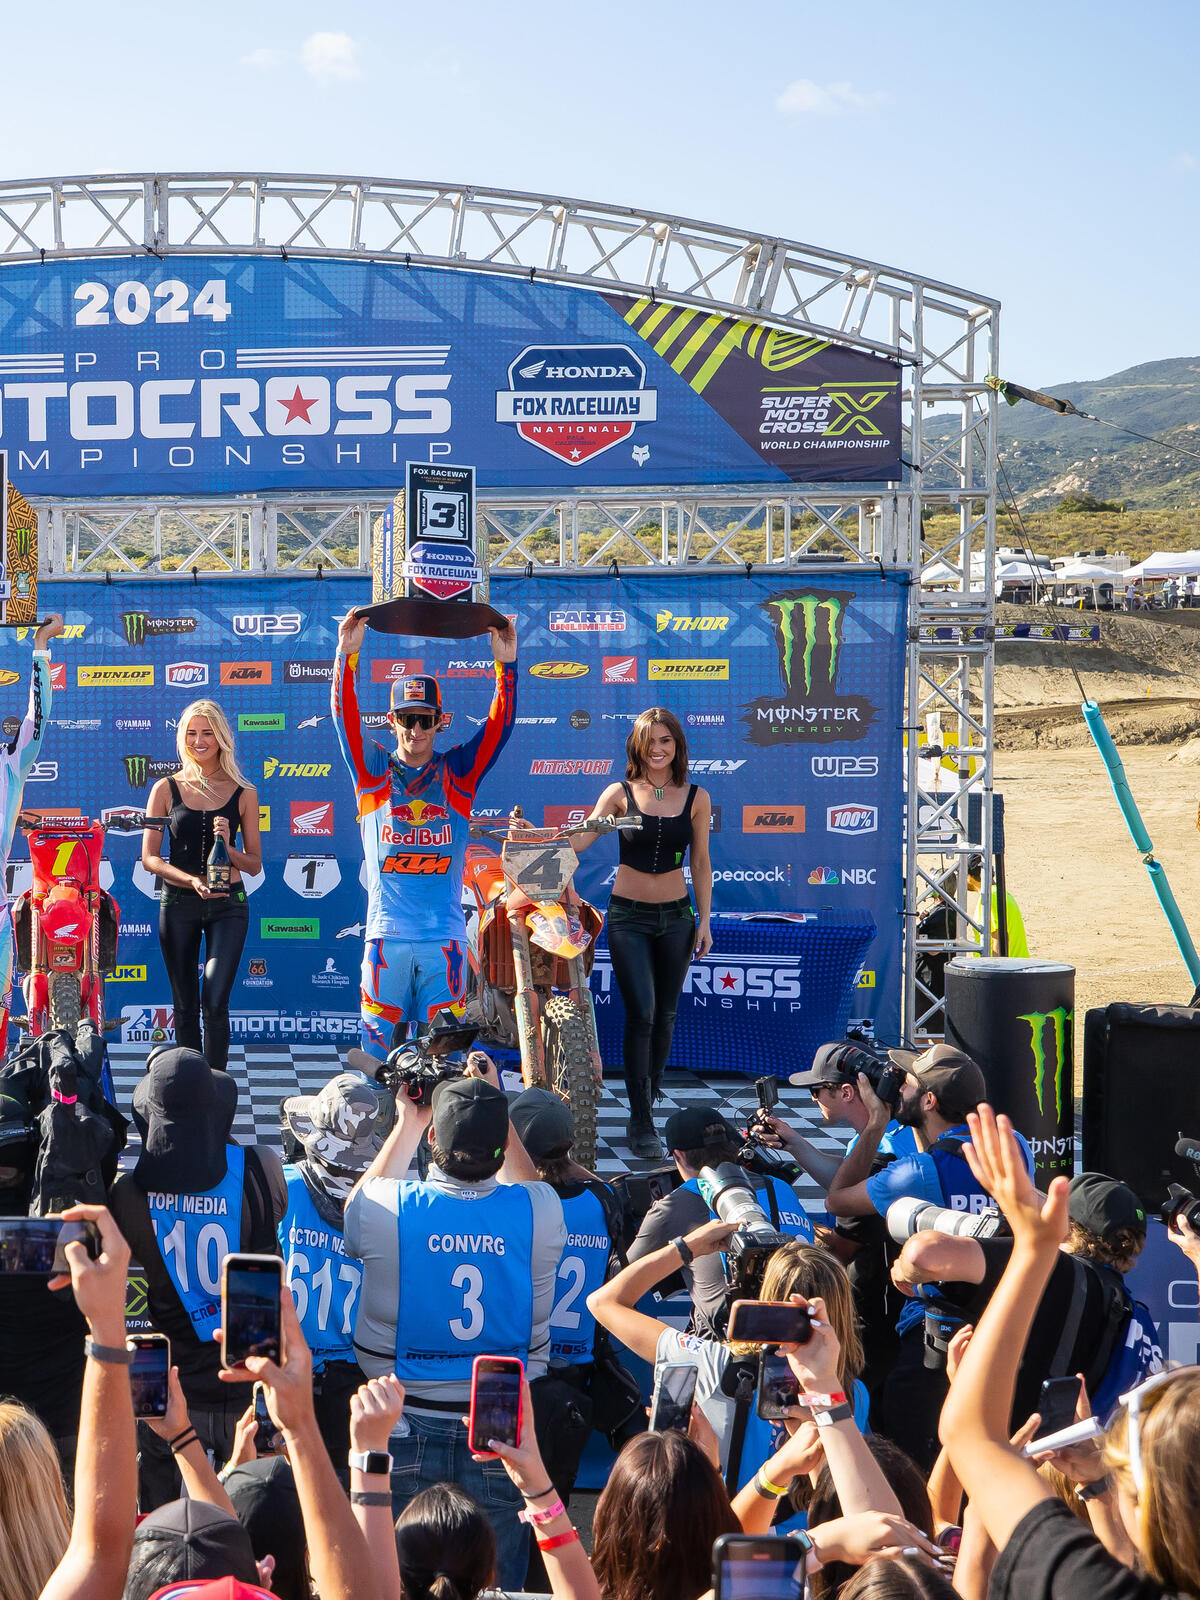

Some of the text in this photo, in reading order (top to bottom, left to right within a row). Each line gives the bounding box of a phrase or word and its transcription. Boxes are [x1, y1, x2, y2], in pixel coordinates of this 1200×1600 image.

[74, 280, 232, 326] 2024
[75, 349, 225, 372] PRO
[546, 366, 634, 378] HONDA
[513, 396, 641, 416] FOX RACEWAY
[761, 396, 831, 409] SUPER
[766, 409, 828, 421] MOTO
[533, 425, 620, 433] NATIONAL
[759, 421, 828, 434] CROSS
[761, 439, 890, 450] WORLD CHAMPIONSHIP
[413, 468, 468, 478] FOX RACEWAY
[429, 502, 457, 528] 3
[426, 553, 473, 562] HONDA
[408, 565, 478, 579] FOX RACEWAY
[147, 618, 194, 628] MONSTER
[550, 612, 625, 623] PARTS
[672, 617, 729, 631] THOR
[232, 614, 302, 636] WPS
[551, 623, 625, 631] UNLIMITED
[92, 671, 151, 680] DUNLOP
[171, 668, 203, 680] 100%
[230, 668, 263, 679] KTM
[302, 667, 334, 678] Husqv
[435, 669, 496, 678] LEGEND
[528, 663, 590, 678] FMF
[663, 664, 726, 673] DUNLOP
[696, 715, 725, 723] YAMAHA
[756, 705, 861, 723] MONSTER
[123, 719, 151, 728] YAMAHA
[244, 718, 280, 726] Kawasaki
[149, 762, 182, 770] MONST
[279, 763, 332, 777] THOR
[812, 757, 878, 777] WPS
[754, 812, 795, 826] KTM
[834, 812, 871, 827] 100%
[381, 825, 452, 846] Red Bull
[51, 841, 79, 876] 1
[382, 853, 452, 874] KTM
[518, 850, 563, 890] 4
[711, 866, 785, 887] peacock
[841, 868, 877, 885] NBC
[268, 924, 313, 933] Kawasaki
[251, 965, 265, 974] 66
[128, 1009, 175, 1029] AM
[127, 1031, 149, 1042] 100
[183, 1195, 228, 1216] MEDIA
[289, 1227, 329, 1249] OCTOPI
[428, 1234, 505, 1256] CONVRG
[286, 1252, 361, 1334] 617
[550, 1256, 586, 1330] 2
[449, 1264, 485, 1341] 3
